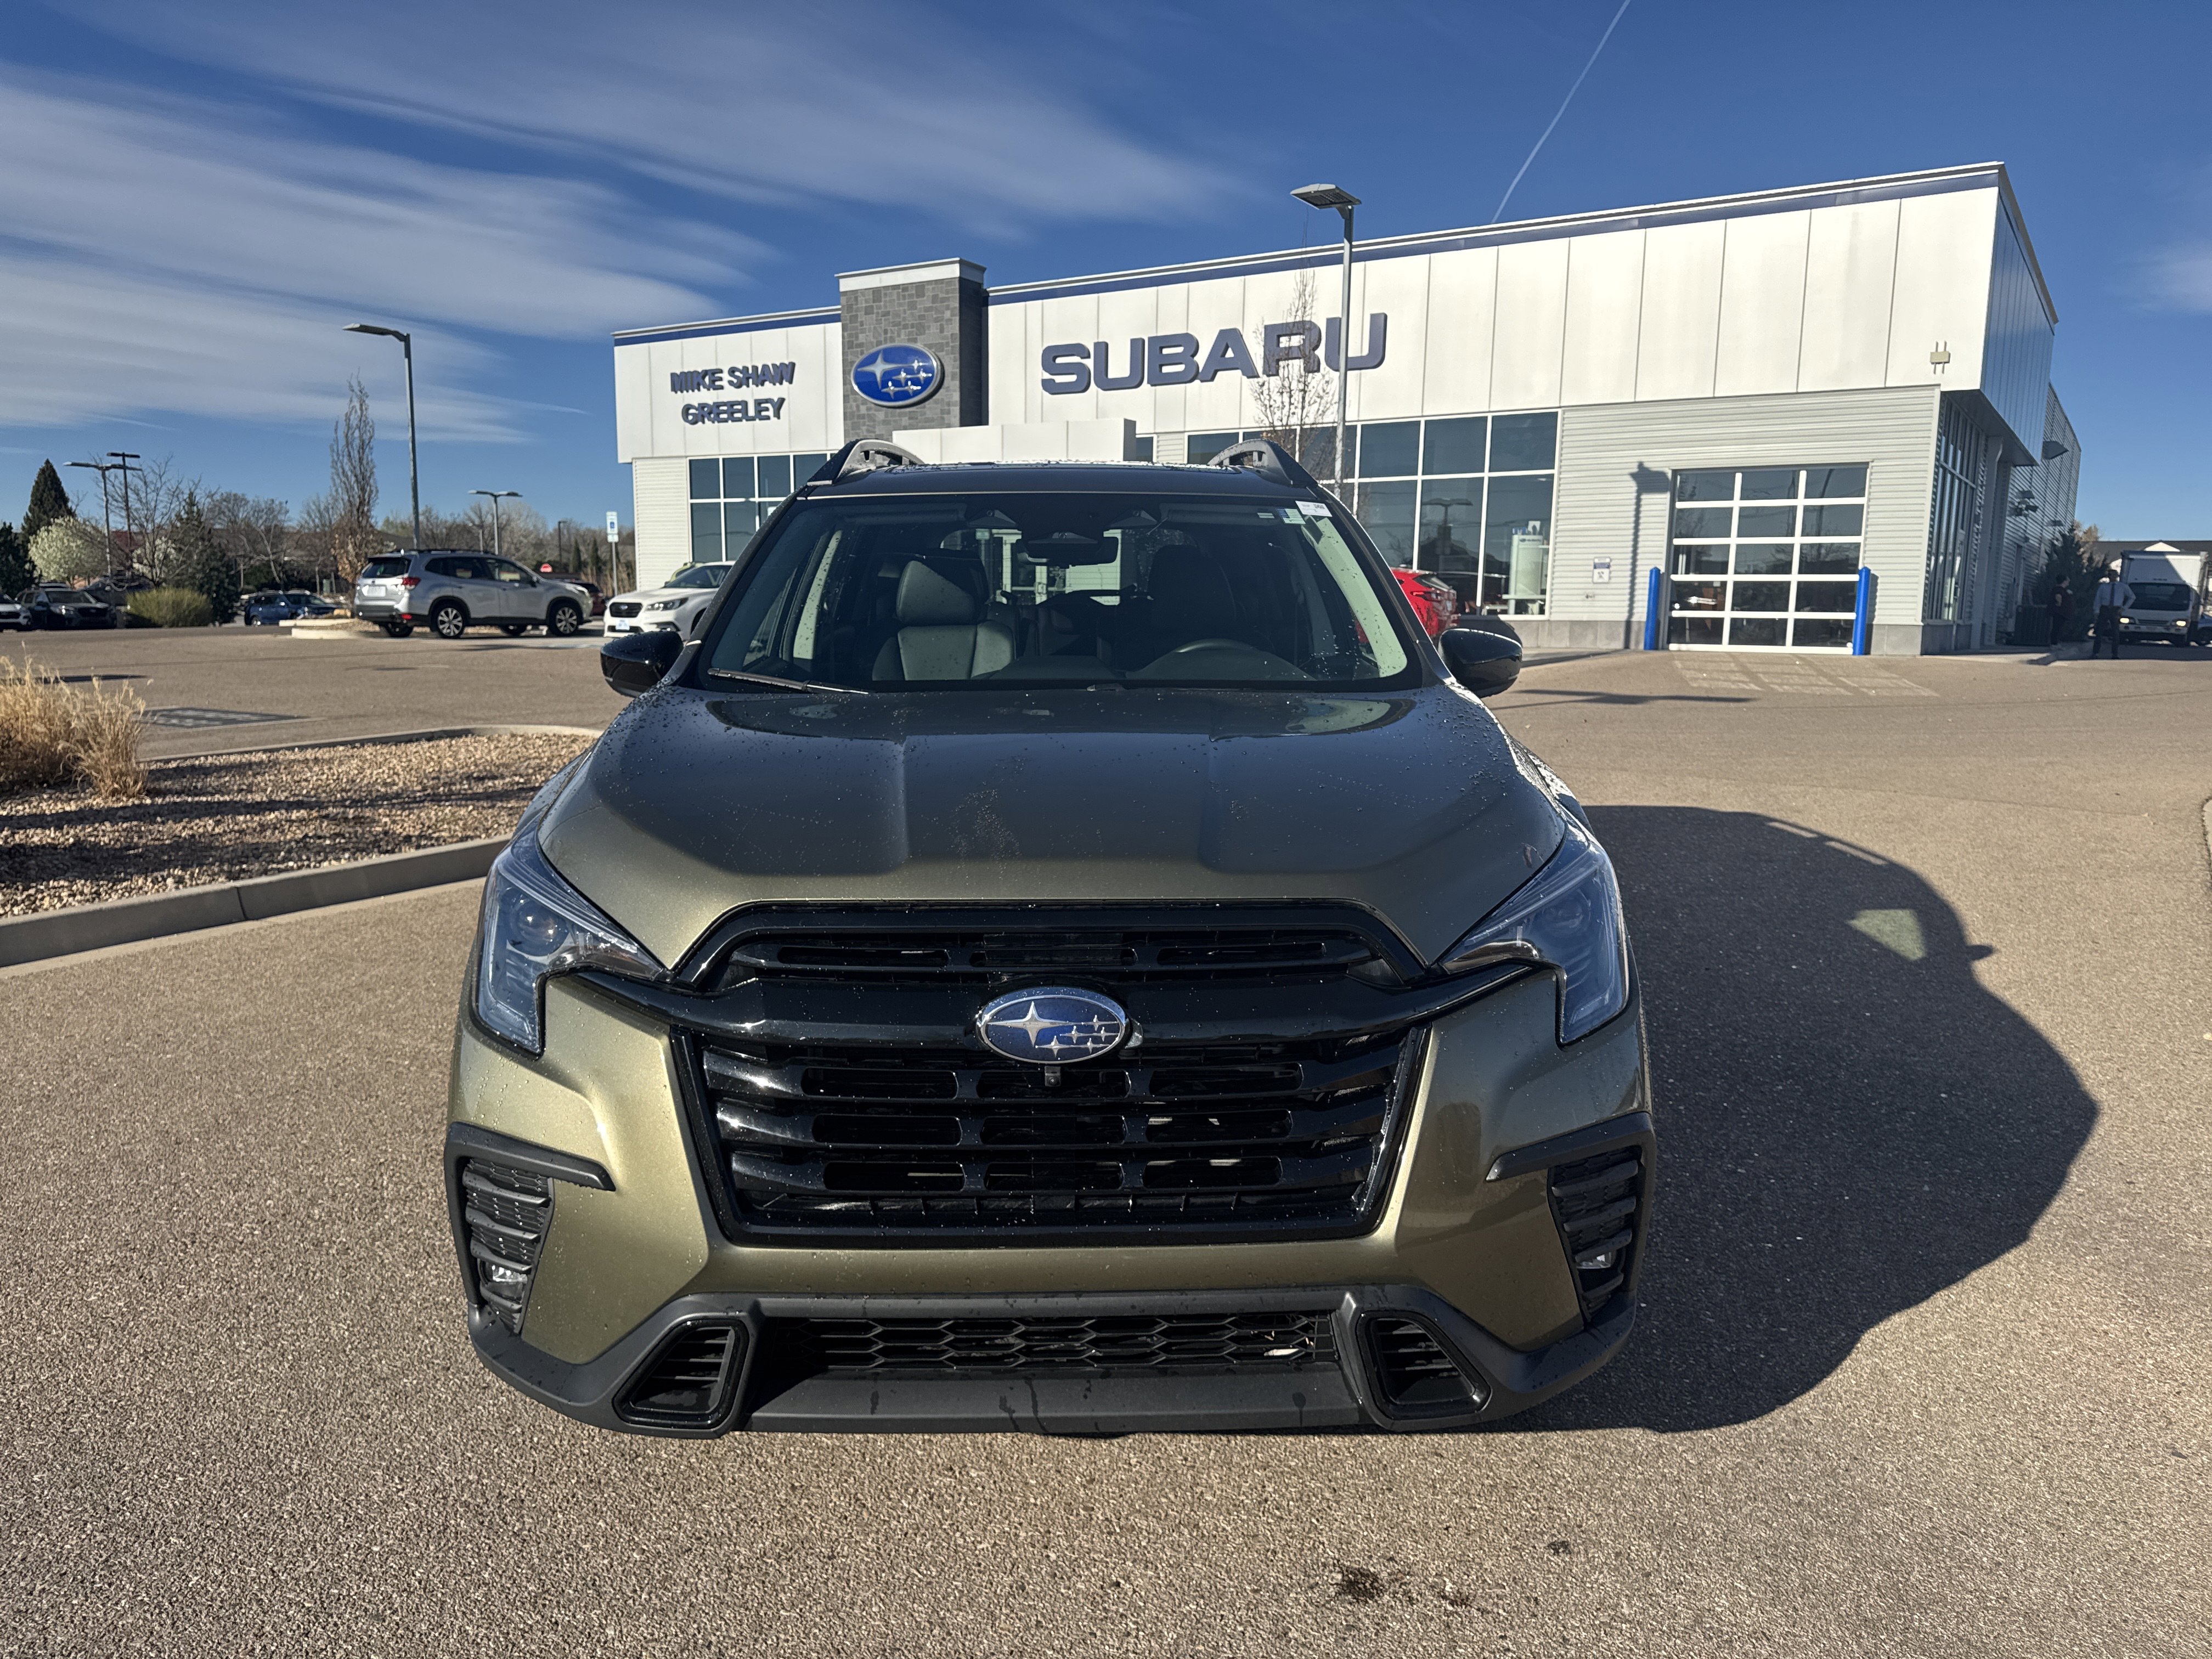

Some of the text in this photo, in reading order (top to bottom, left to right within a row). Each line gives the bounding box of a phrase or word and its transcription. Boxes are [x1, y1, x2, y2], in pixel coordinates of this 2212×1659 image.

[1041, 312, 1387, 395] SUBARU
[670, 361, 795, 394] MIKE SHAW
[681, 397, 786, 425] GREELEY
